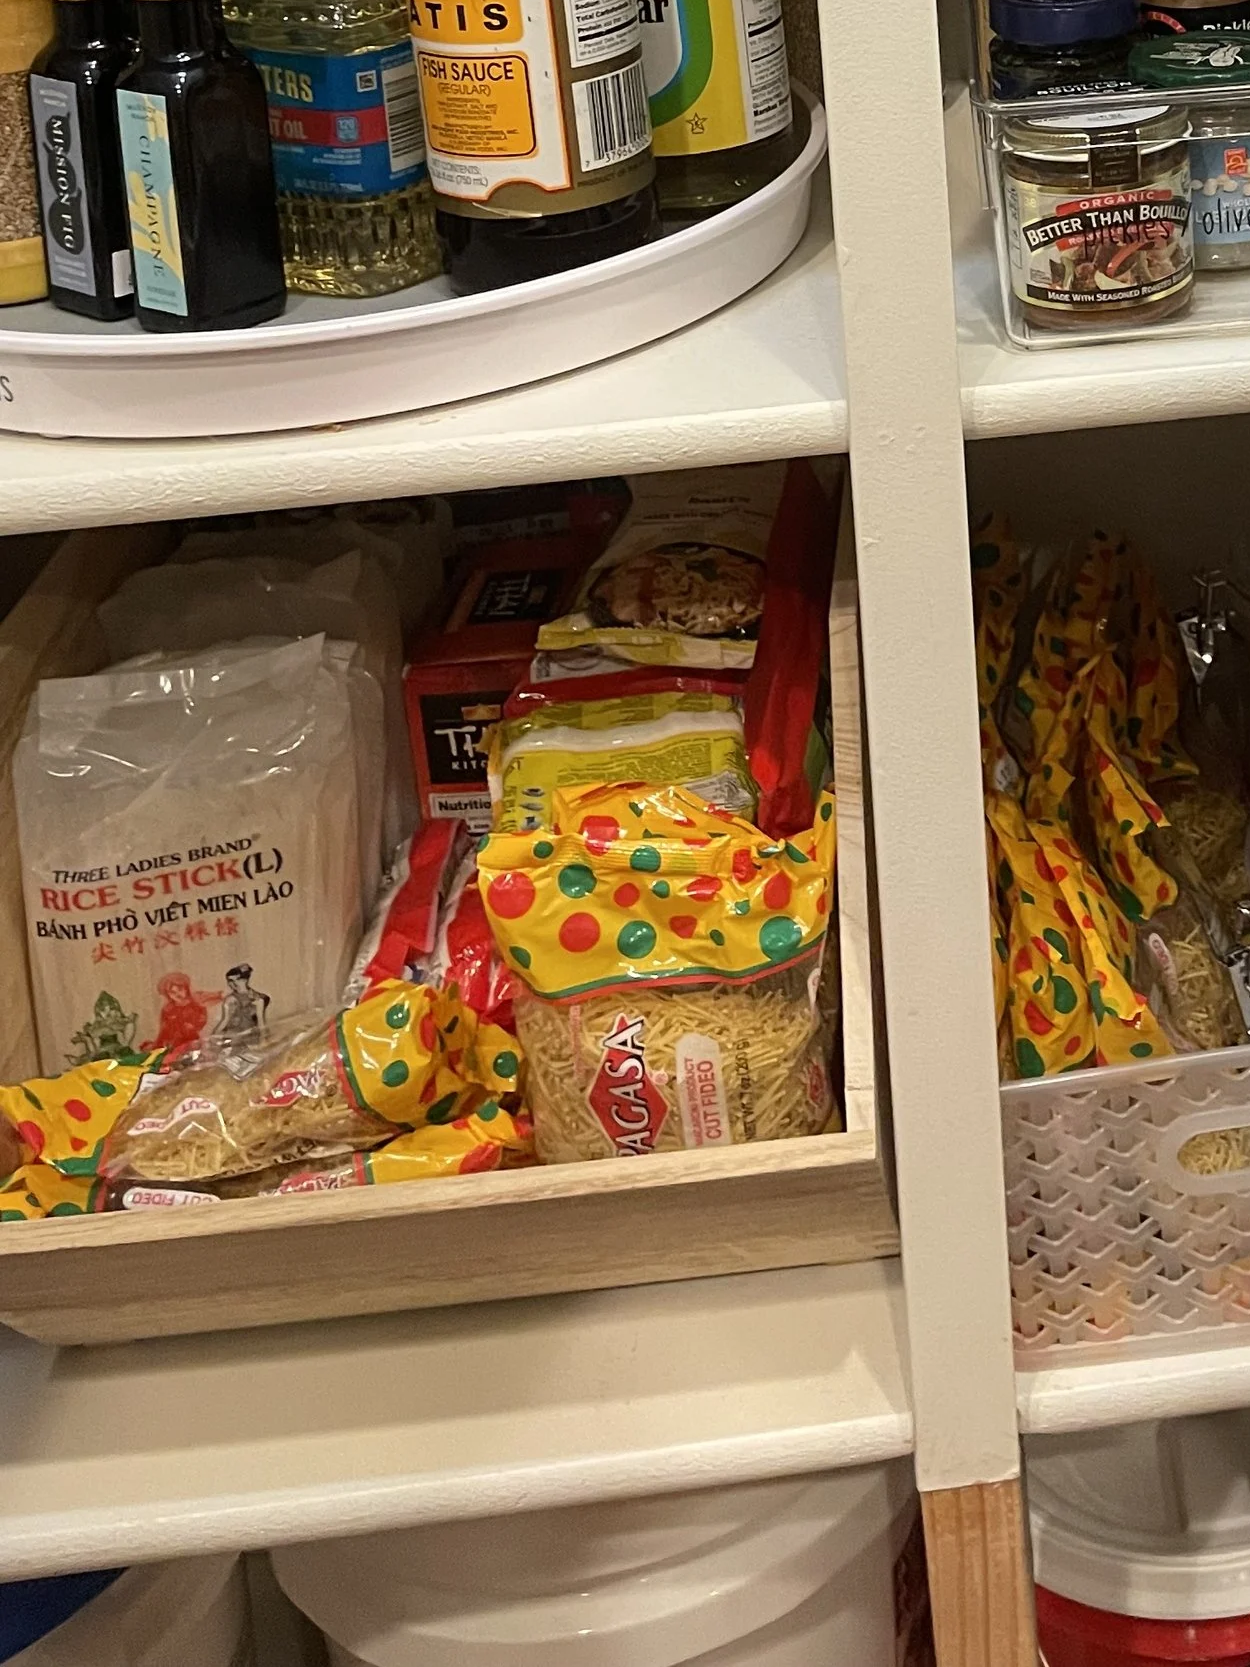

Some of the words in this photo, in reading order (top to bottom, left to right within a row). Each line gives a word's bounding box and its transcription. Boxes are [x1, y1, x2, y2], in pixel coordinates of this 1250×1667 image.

[256, 63, 314, 103] TERS
[422, 58, 447, 82] FISH
[450, 61, 515, 82] SAUCE
[437, 82, 492, 97] (REGULAR)
[49, 117, 74, 206] MISSION
[138, 135, 167, 279] CHAMPAGNE
[1079, 191, 1156, 210] ORGANIC
[60, 210, 76, 251] FIG
[1026, 216, 1084, 246] BETTER
[1086, 210, 1131, 229] THAN
[1138, 201, 1188, 222] BOUILLO
[1072, 291, 1095, 302] WITH
[1096, 288, 1140, 302] SEASONED
[438, 798, 492, 814] Nutritio
[52, 867, 111, 885] THREE
[116, 852, 182, 878] LADIES
[187, 837, 253, 863] BRAND
[35, 918, 88, 941] BÁNH
[196, 890, 248, 916] MIEN
[253, 879, 295, 907] LÀO
[39, 884, 121, 912] RICE
[697, 1060, 719, 1108] FIDEO
[703, 1111, 722, 1140] CUT
[130, 1187, 175, 1206] FIDEO
